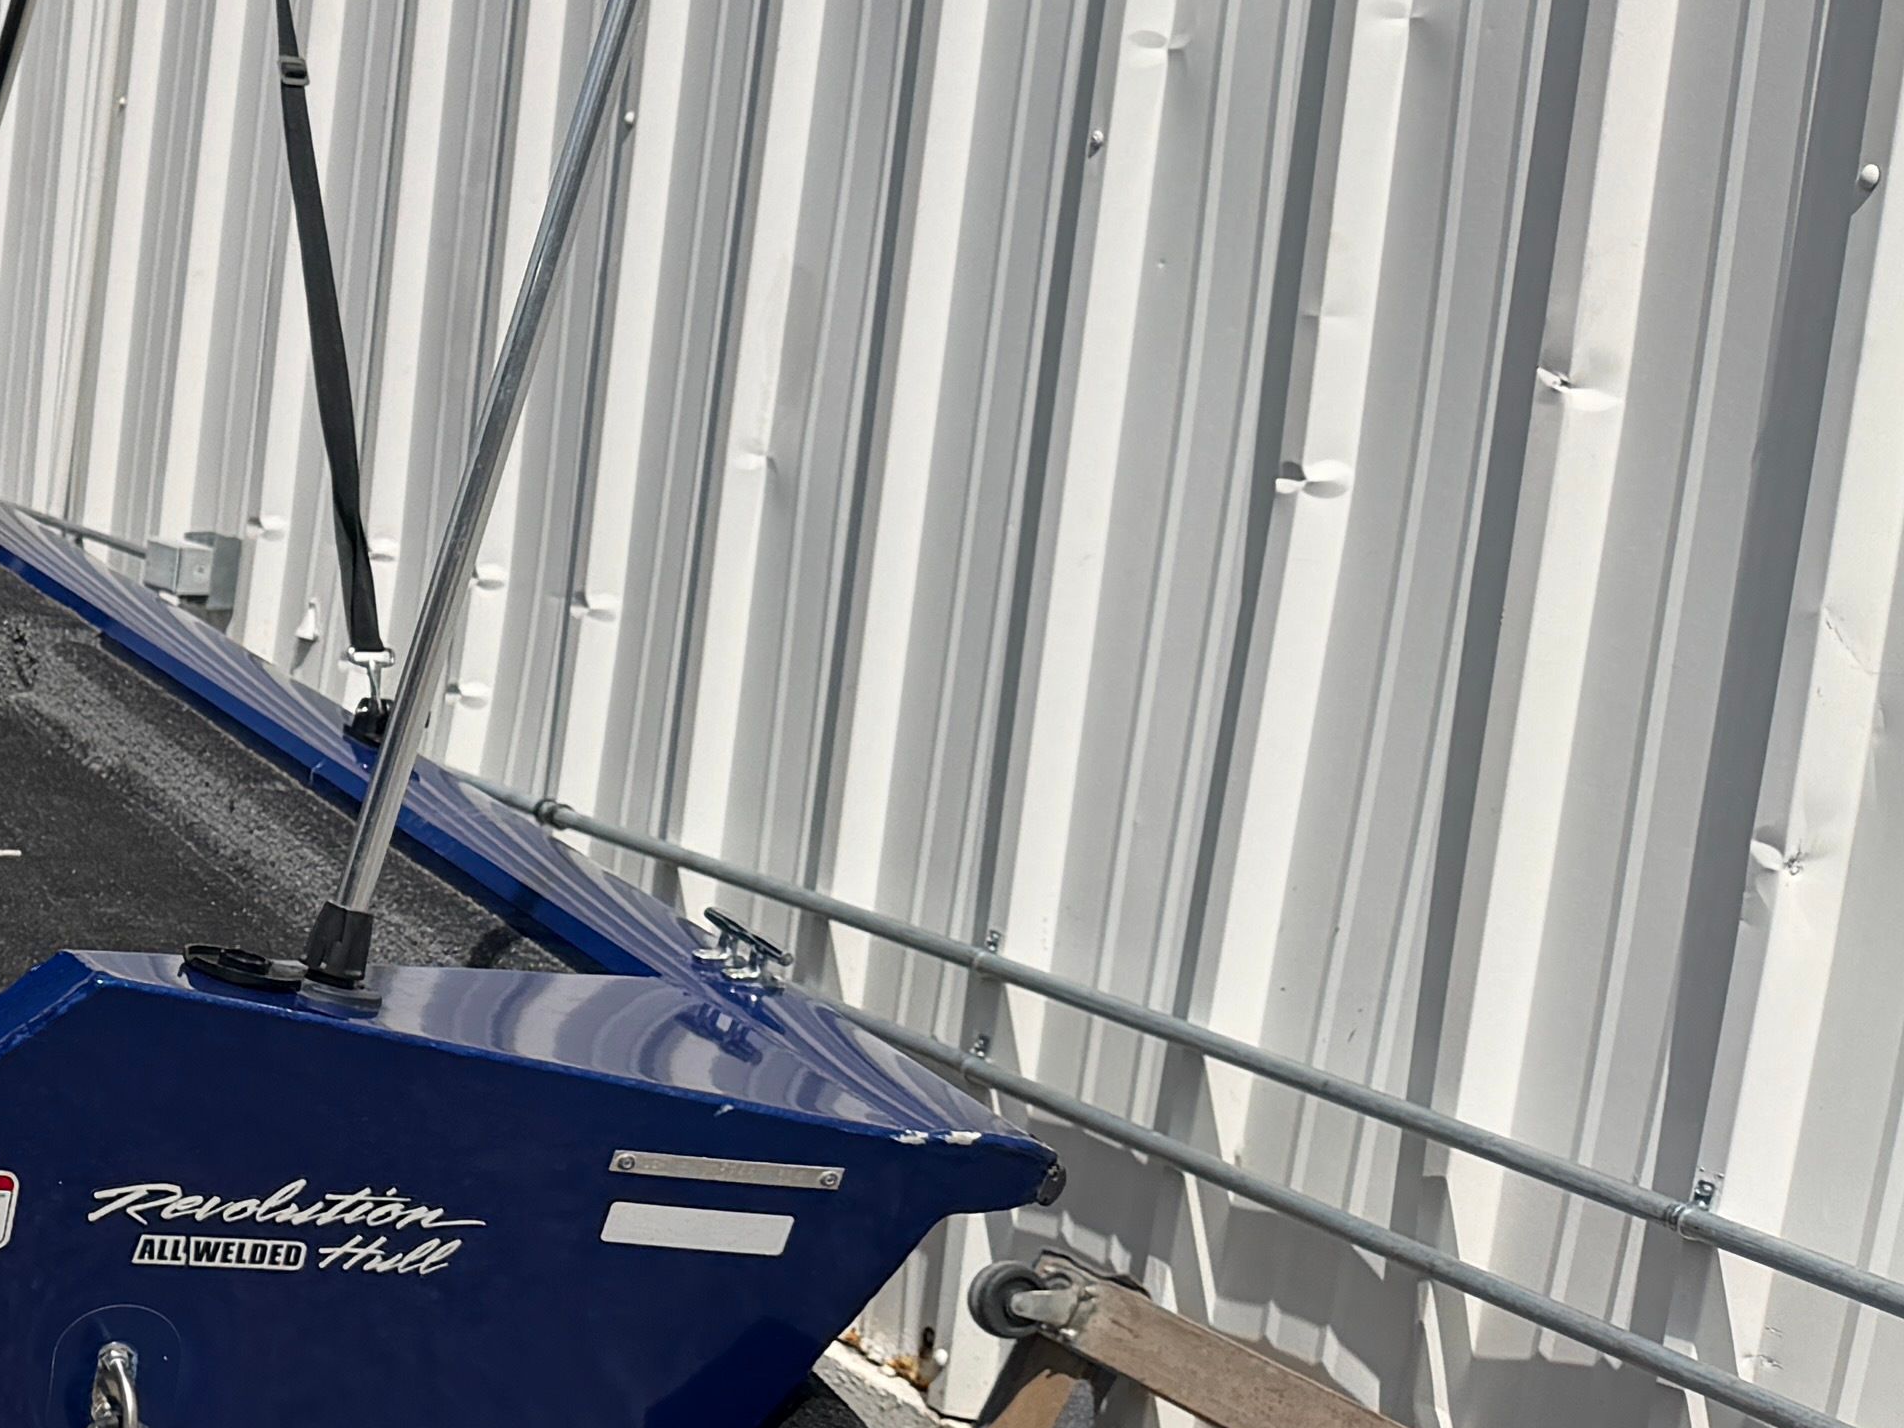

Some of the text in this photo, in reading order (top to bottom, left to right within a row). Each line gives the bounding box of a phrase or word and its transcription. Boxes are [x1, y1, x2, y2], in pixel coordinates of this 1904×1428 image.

[88, 1179, 487, 1229] Revolution
[137, 1235, 462, 1275] ALL WELDED Hull
